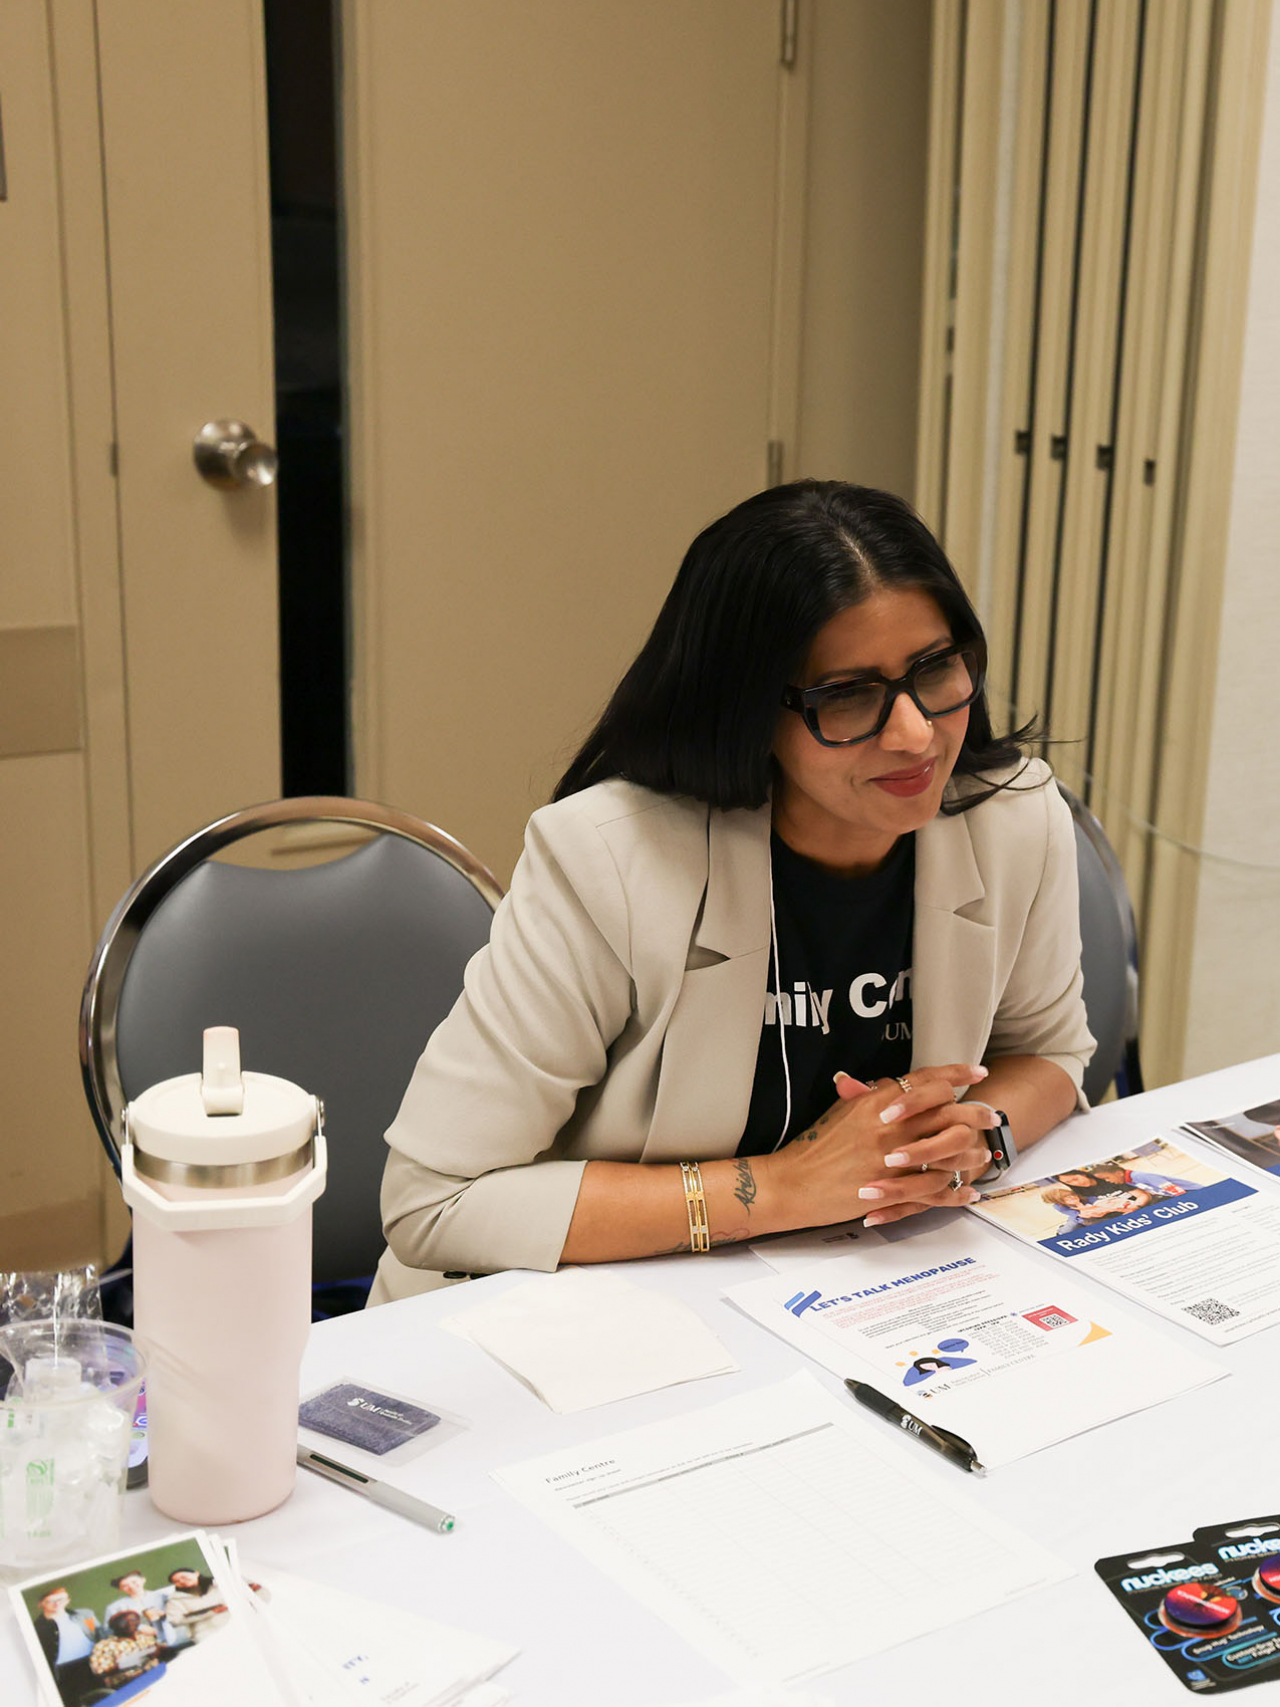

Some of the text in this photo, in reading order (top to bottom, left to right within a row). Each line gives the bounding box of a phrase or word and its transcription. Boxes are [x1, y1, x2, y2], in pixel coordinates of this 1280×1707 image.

[1056, 1231, 1110, 1252] Rady
[1153, 1199, 1199, 1220] Club
[810, 1257, 977, 1312] LET'S TALK MENOPAUSE
[908, 1420, 923, 1436] UM
[545, 1469, 580, 1485] Family
[581, 1458, 616, 1473] Centre
[1121, 1562, 1219, 1592] nuckees
